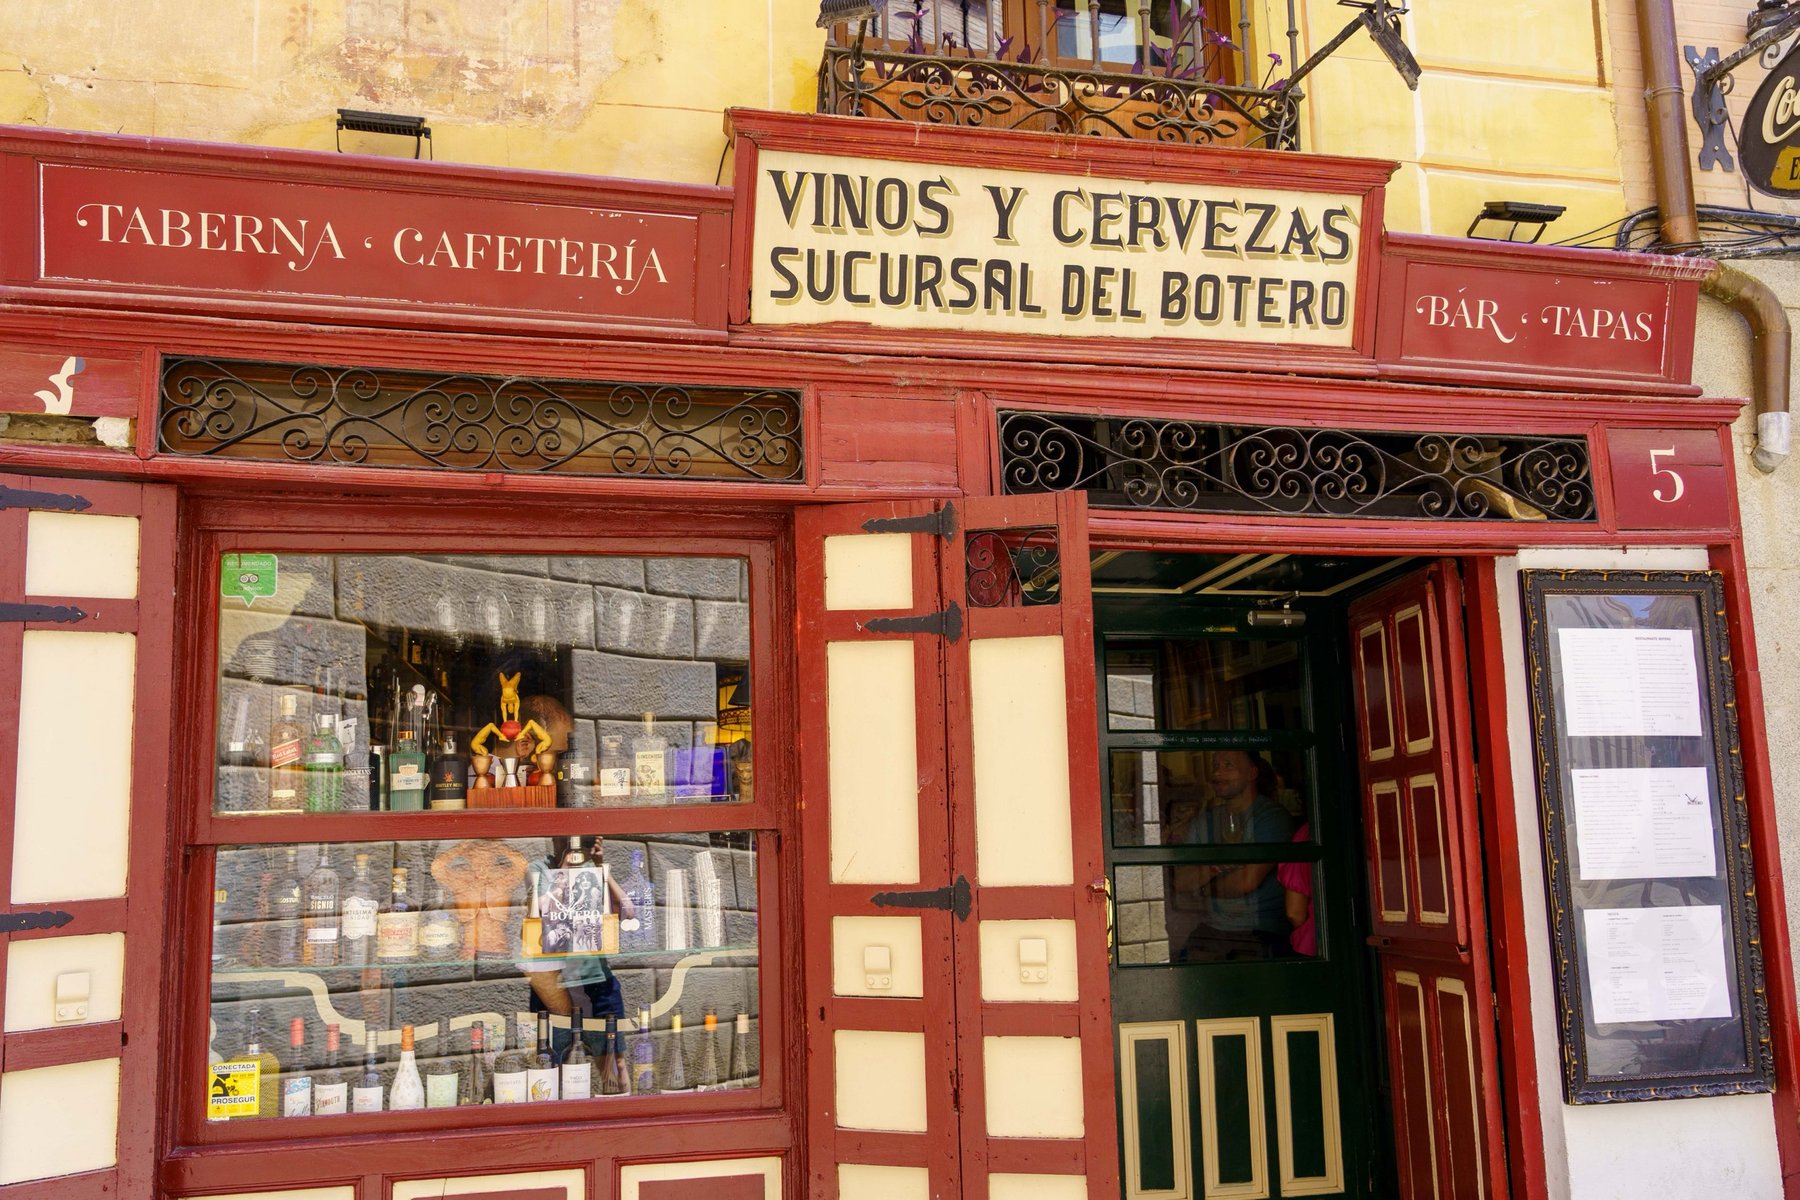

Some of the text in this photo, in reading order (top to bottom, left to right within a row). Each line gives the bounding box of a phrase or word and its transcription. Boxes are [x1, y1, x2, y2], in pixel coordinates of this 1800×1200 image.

[766, 168, 1359, 264] VINOS Y CERVEZAS
[76, 202, 669, 296] TABERNA CAFETERÍA
[769, 246, 1350, 329] SUCURSAL DEL BOTERO
[1416, 287, 1653, 343] BÁR TAPAS
[1648, 445, 1685, 503] 5
[549, 909, 601, 921] BOTERO
[213, 1063, 256, 1071] CONECTADA
[212, 1096, 256, 1104] PROSEGUR
